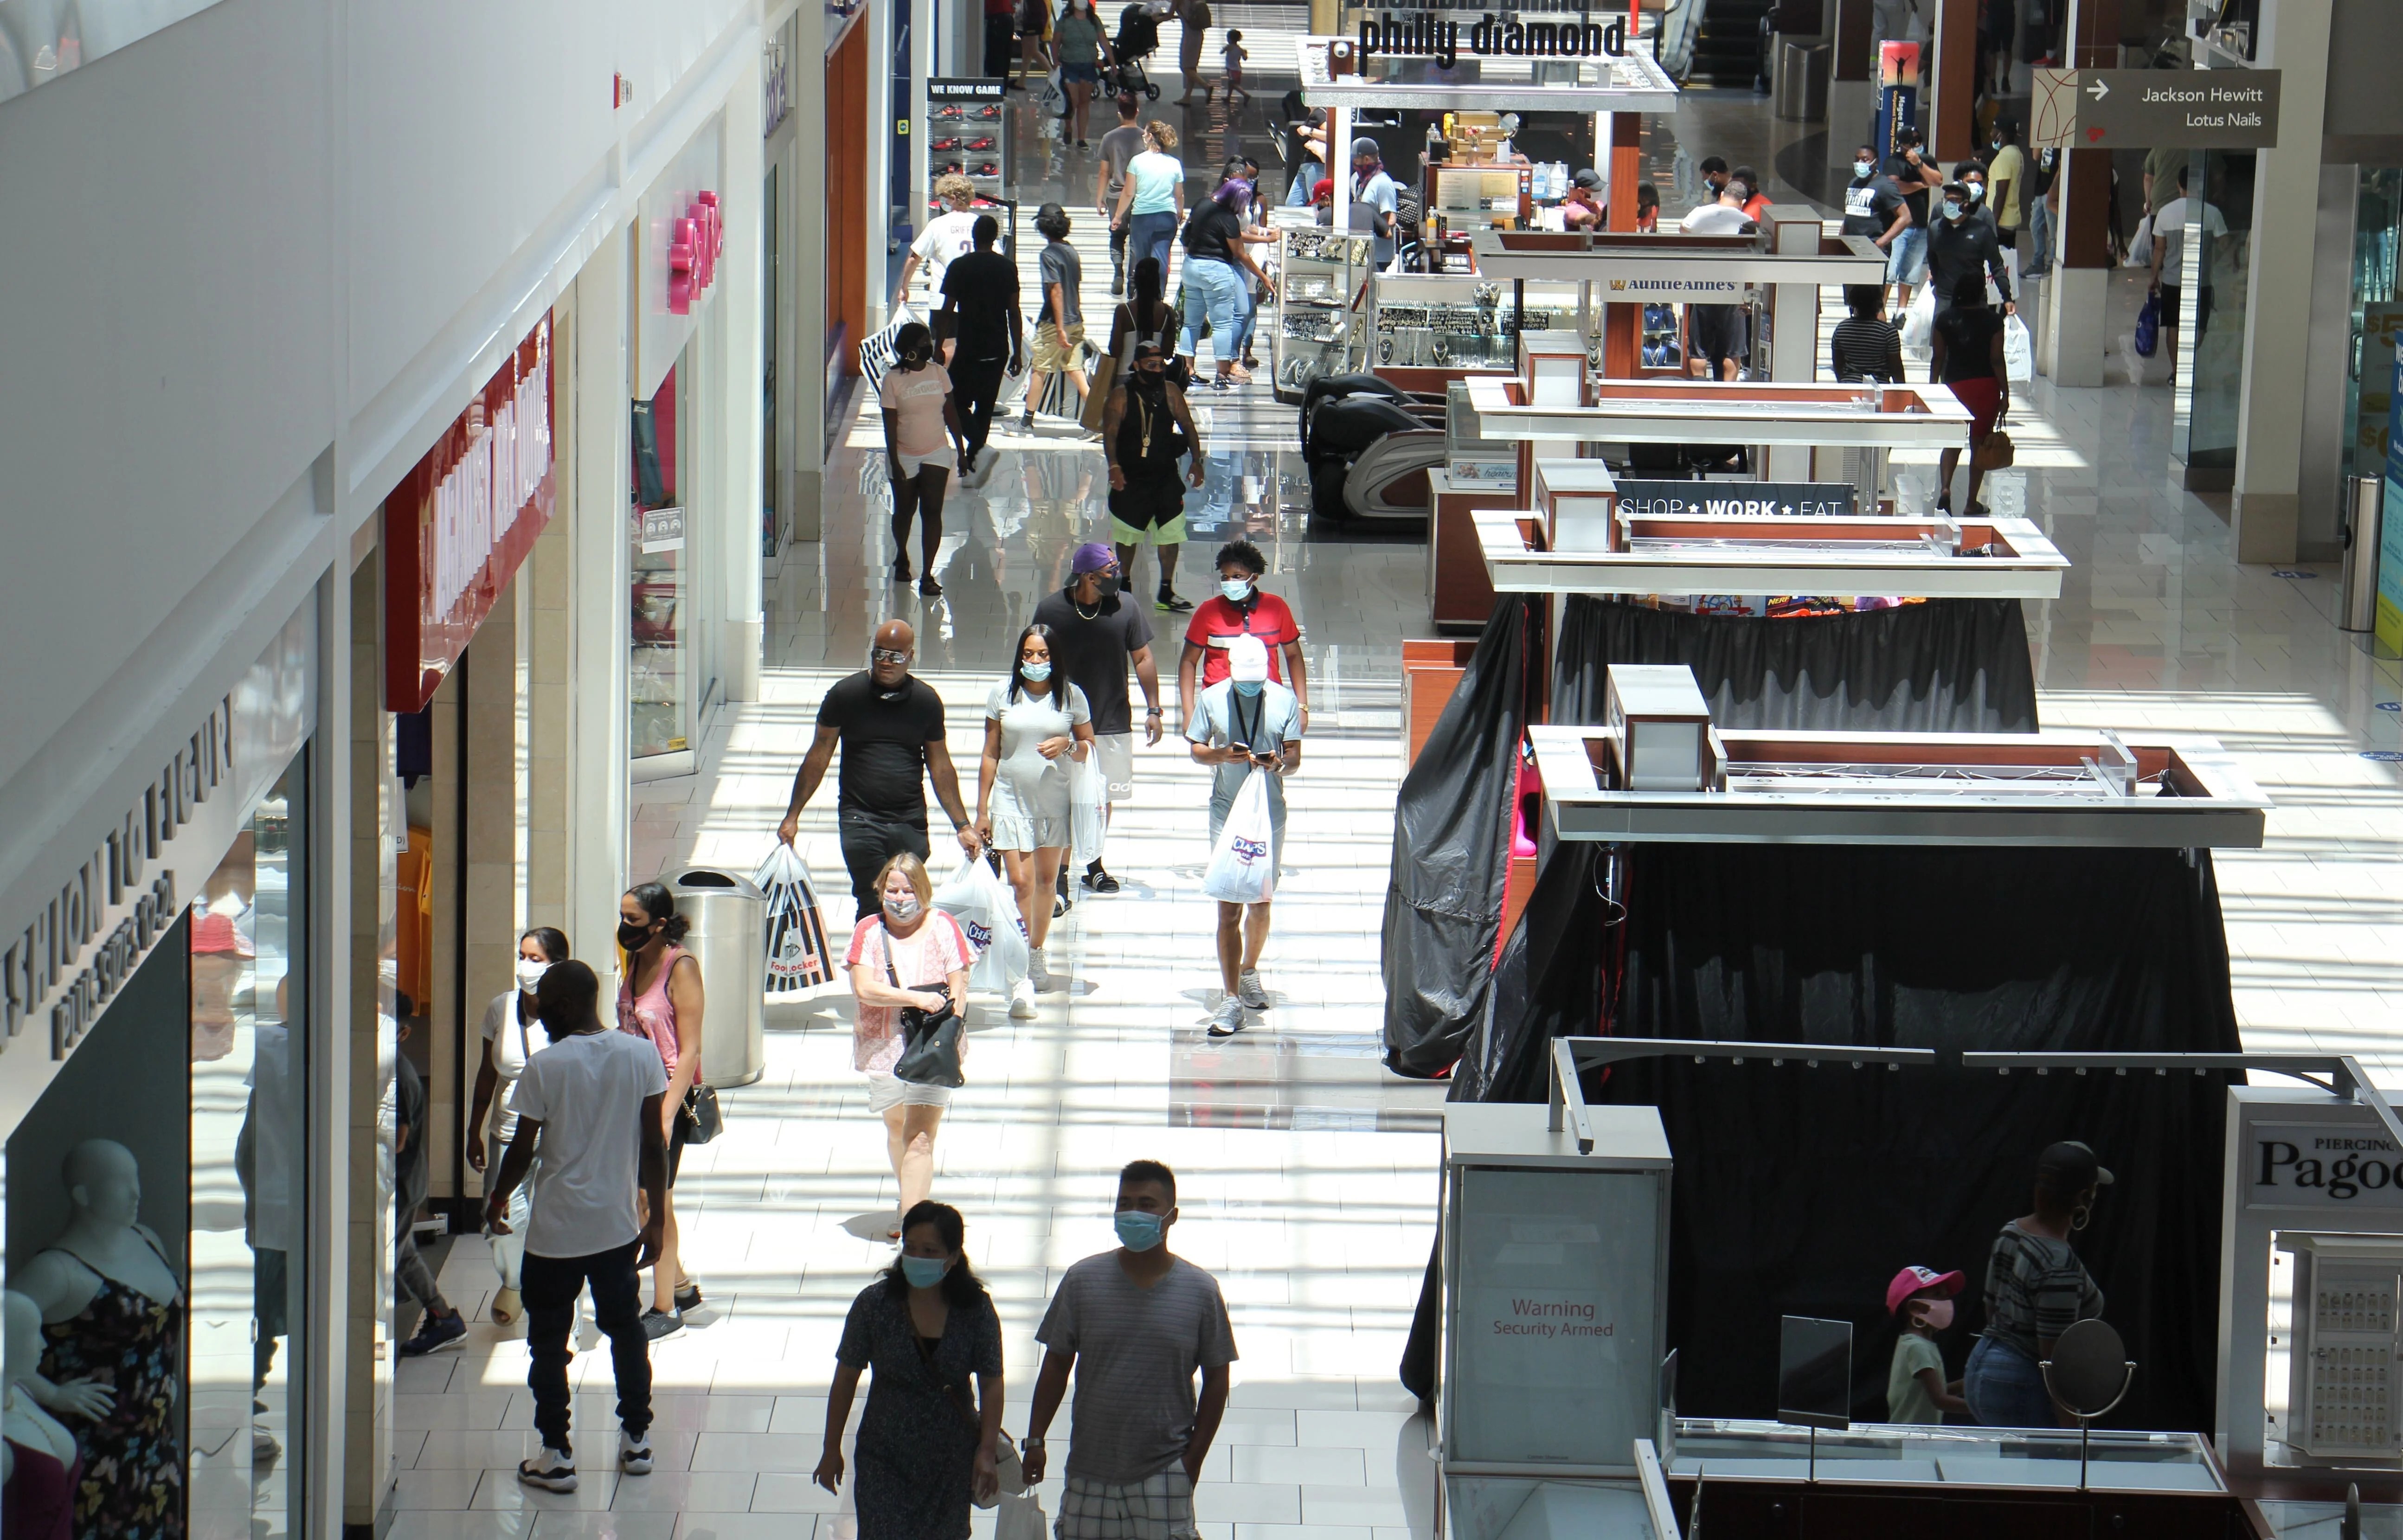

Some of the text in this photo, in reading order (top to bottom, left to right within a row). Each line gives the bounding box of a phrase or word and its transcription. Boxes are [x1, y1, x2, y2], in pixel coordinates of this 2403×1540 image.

[1359, 12, 1626, 77] philly diamond
[931, 85, 1002, 95] WE KNOW GAME
[2142, 87, 2263, 102] Jackson Hewitt
[1896, 96, 1905, 121] Magee
[2186, 112, 2262, 127] Lotus Nails
[950, 225, 971, 234] GRIFF
[1620, 499, 1683, 514] SHOP
[1705, 500, 1778, 515] WORK
[1768, 596, 1790, 606] NERF
[2255, 1141, 2403, 1200] Pago
[1512, 1299, 1594, 1322] Warning
[1493, 1321, 1613, 1339] Security Armed
